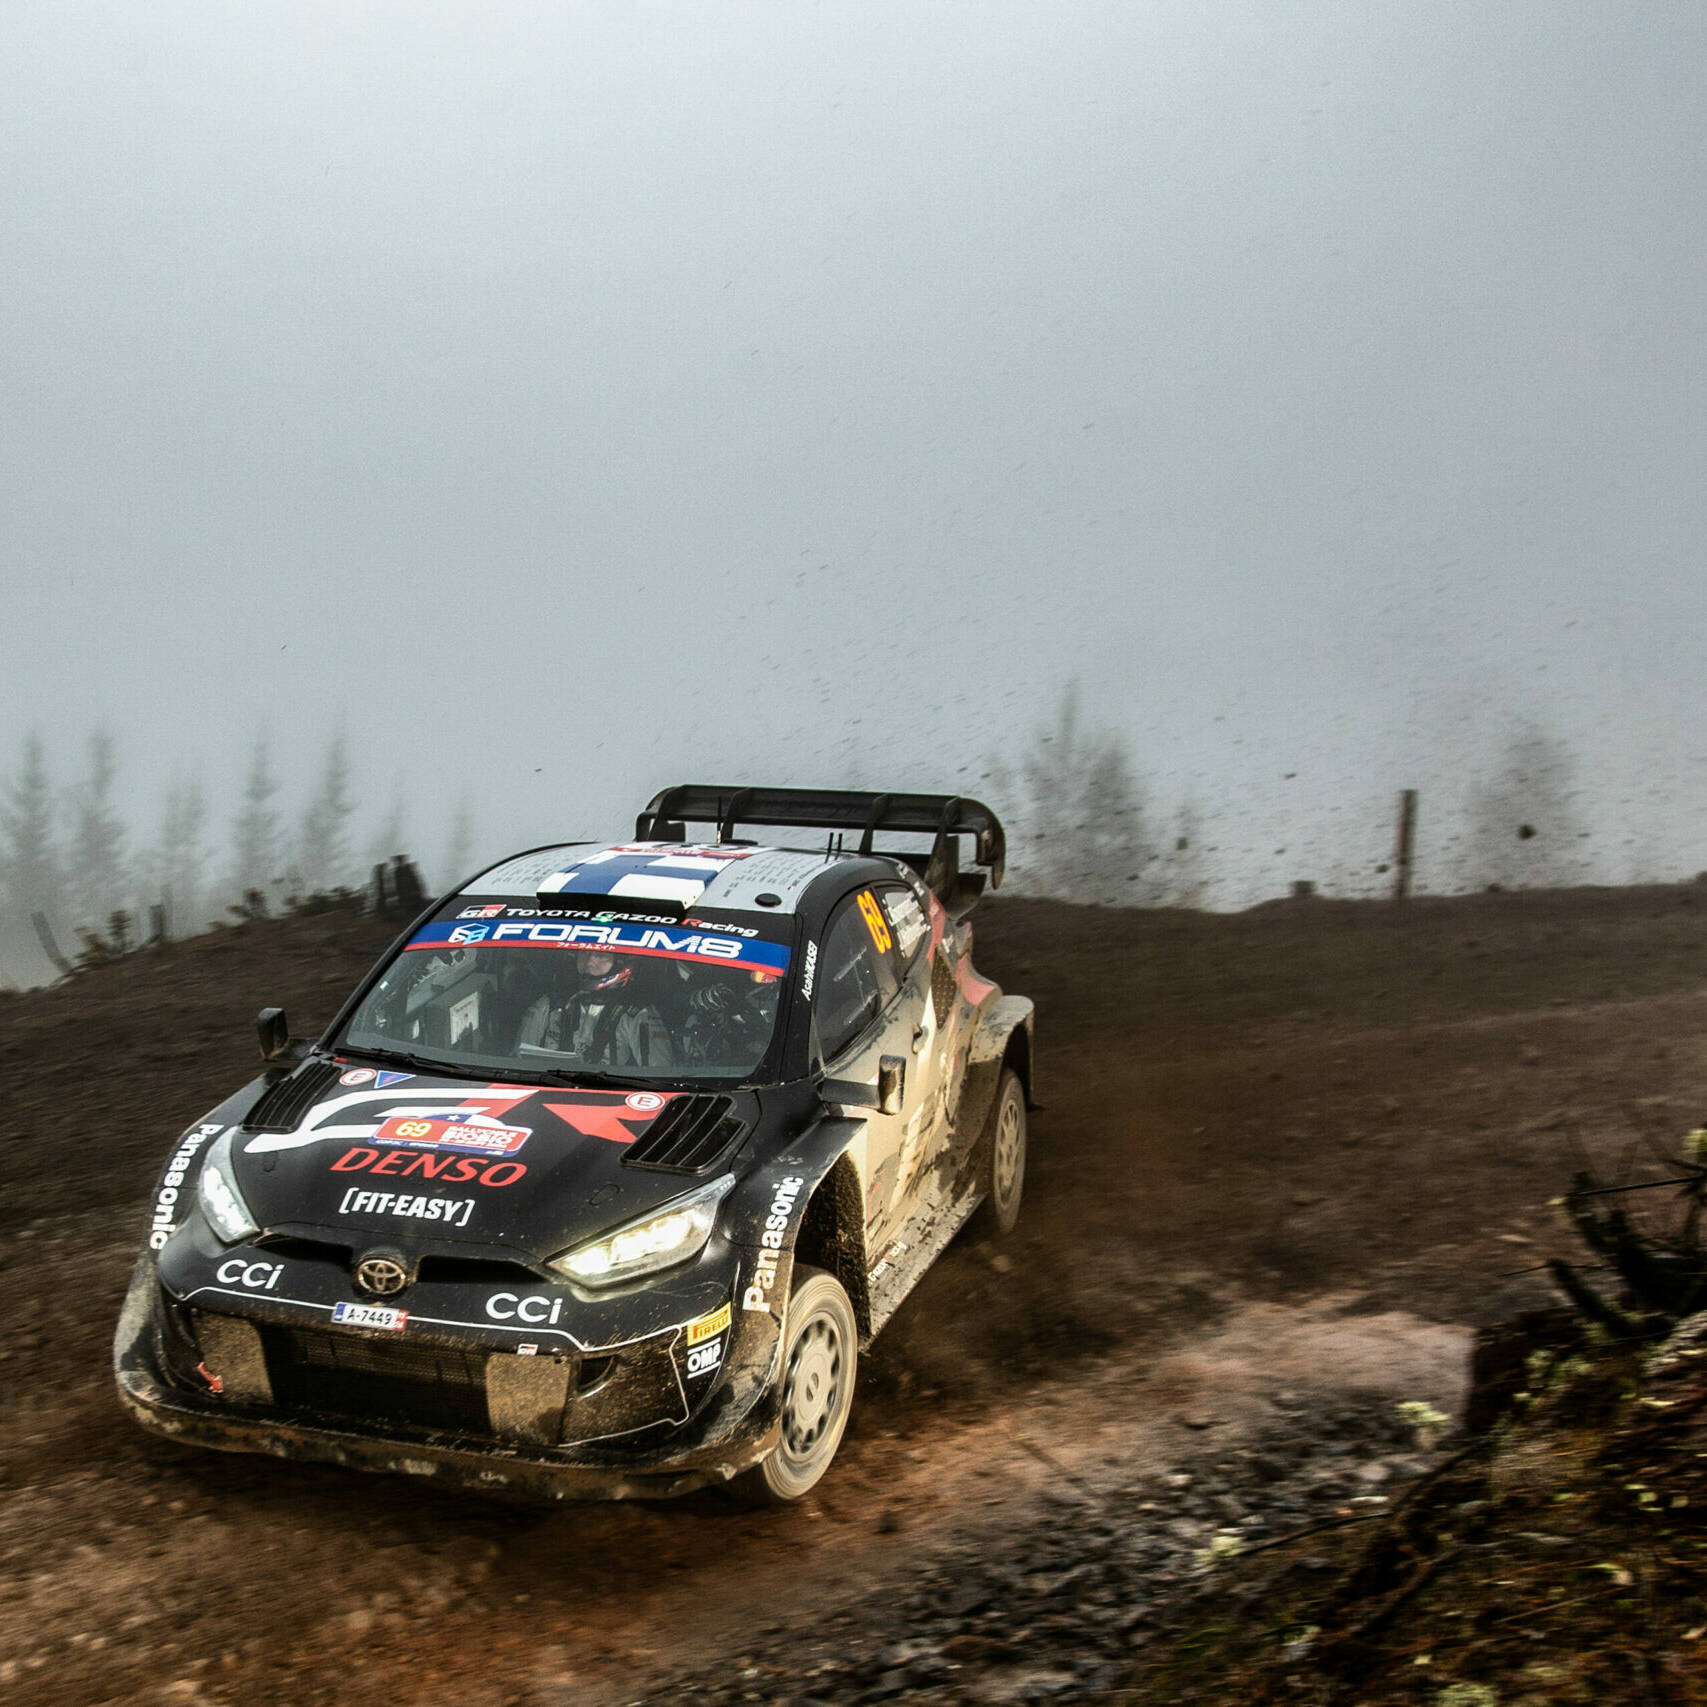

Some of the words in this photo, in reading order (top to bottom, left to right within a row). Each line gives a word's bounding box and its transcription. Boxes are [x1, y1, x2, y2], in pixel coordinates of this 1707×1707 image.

[506, 908, 590, 918] TOYOTA
[591, 911, 677, 925] GAZOO
[681, 917, 759, 938] Racing
[857, 890, 892, 954] 69
[492, 923, 743, 959] FORUM8
[395, 1121, 433, 1138] 69
[329, 1147, 528, 1187] DENSO
[150, 1123, 225, 1250] Panasonic
[742, 1176, 804, 1313] Panasonic
[346, 1308, 393, 1325] A-7449
[692, 1309, 729, 1340] PIRELLI
[687, 1343, 721, 1372] OMP
